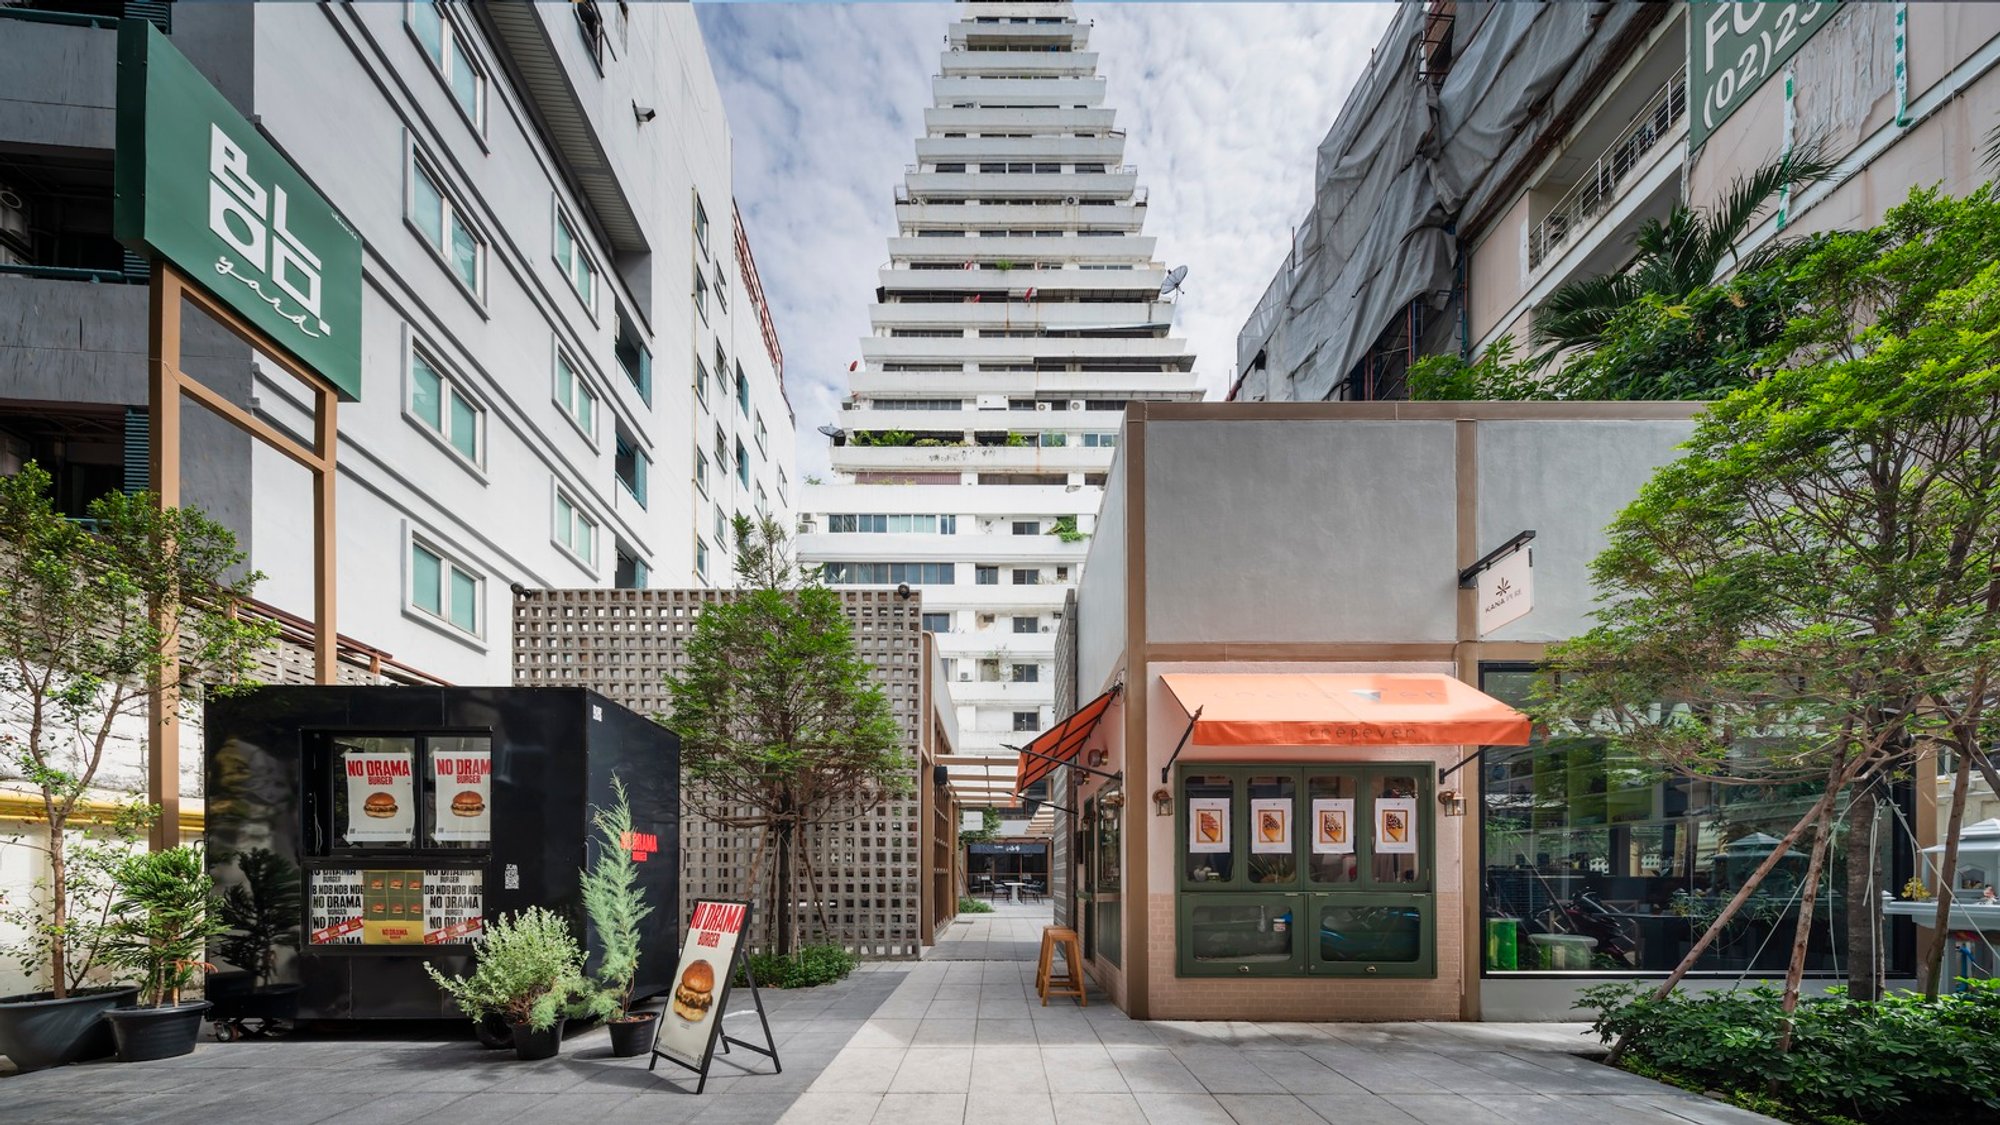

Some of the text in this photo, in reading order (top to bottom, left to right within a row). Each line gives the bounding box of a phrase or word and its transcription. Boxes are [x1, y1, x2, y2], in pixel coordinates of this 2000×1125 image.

[215, 256, 319, 338] yard
[347, 760, 410, 776] NO DRAMA
[436, 759, 453, 775] NO
[368, 776, 393, 785] BURGER
[456, 775, 481, 784] BURGER
[313, 896, 361, 908] NO DRAMA
[430, 896, 479, 908] NO DRAMA
[313, 917, 325, 929] NO
[430, 917, 442, 929] NO
[690, 902, 746, 933] NO DRAMA
[697, 931, 720, 948] BURGER
